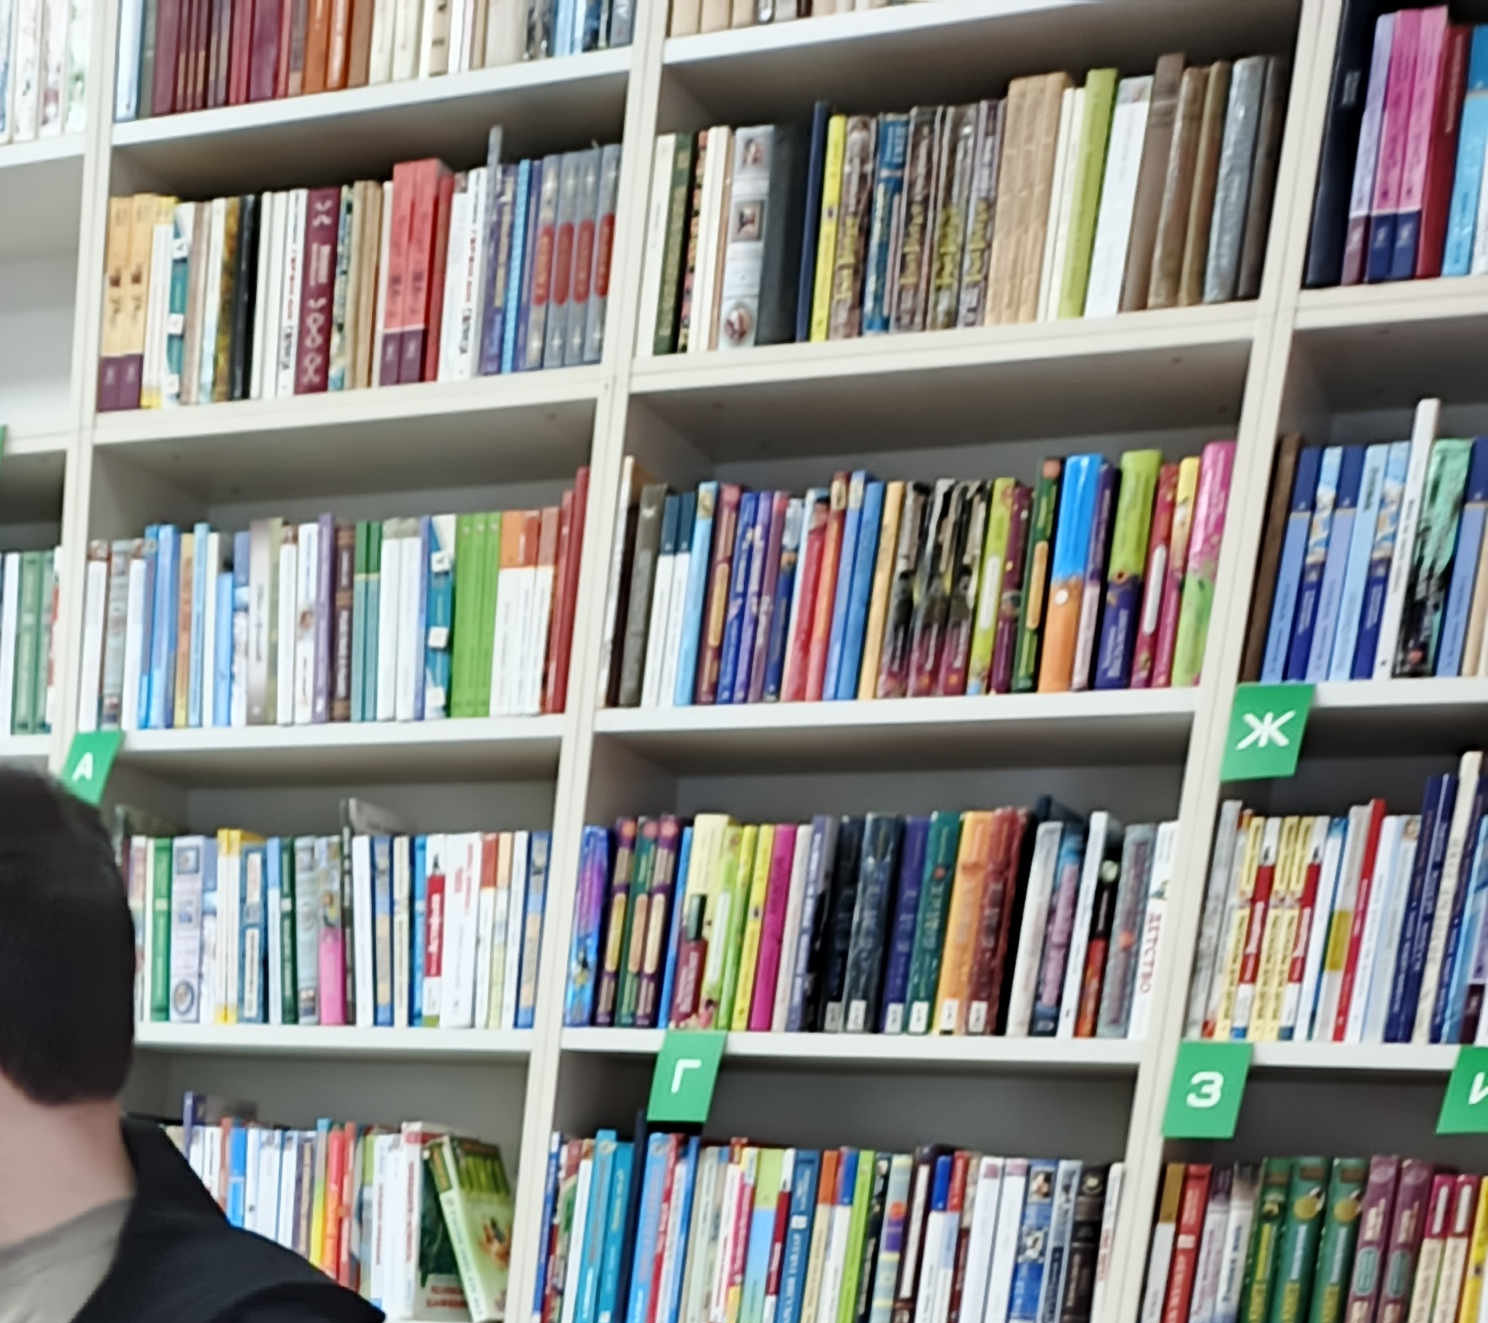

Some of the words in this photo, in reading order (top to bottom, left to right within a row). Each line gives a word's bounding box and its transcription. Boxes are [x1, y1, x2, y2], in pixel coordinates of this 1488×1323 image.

[1235, 710, 1297, 750] Ж
[71, 752, 94, 782] А
[671, 1058, 702, 1094] Г
[1186, 1071, 1224, 1108] З
